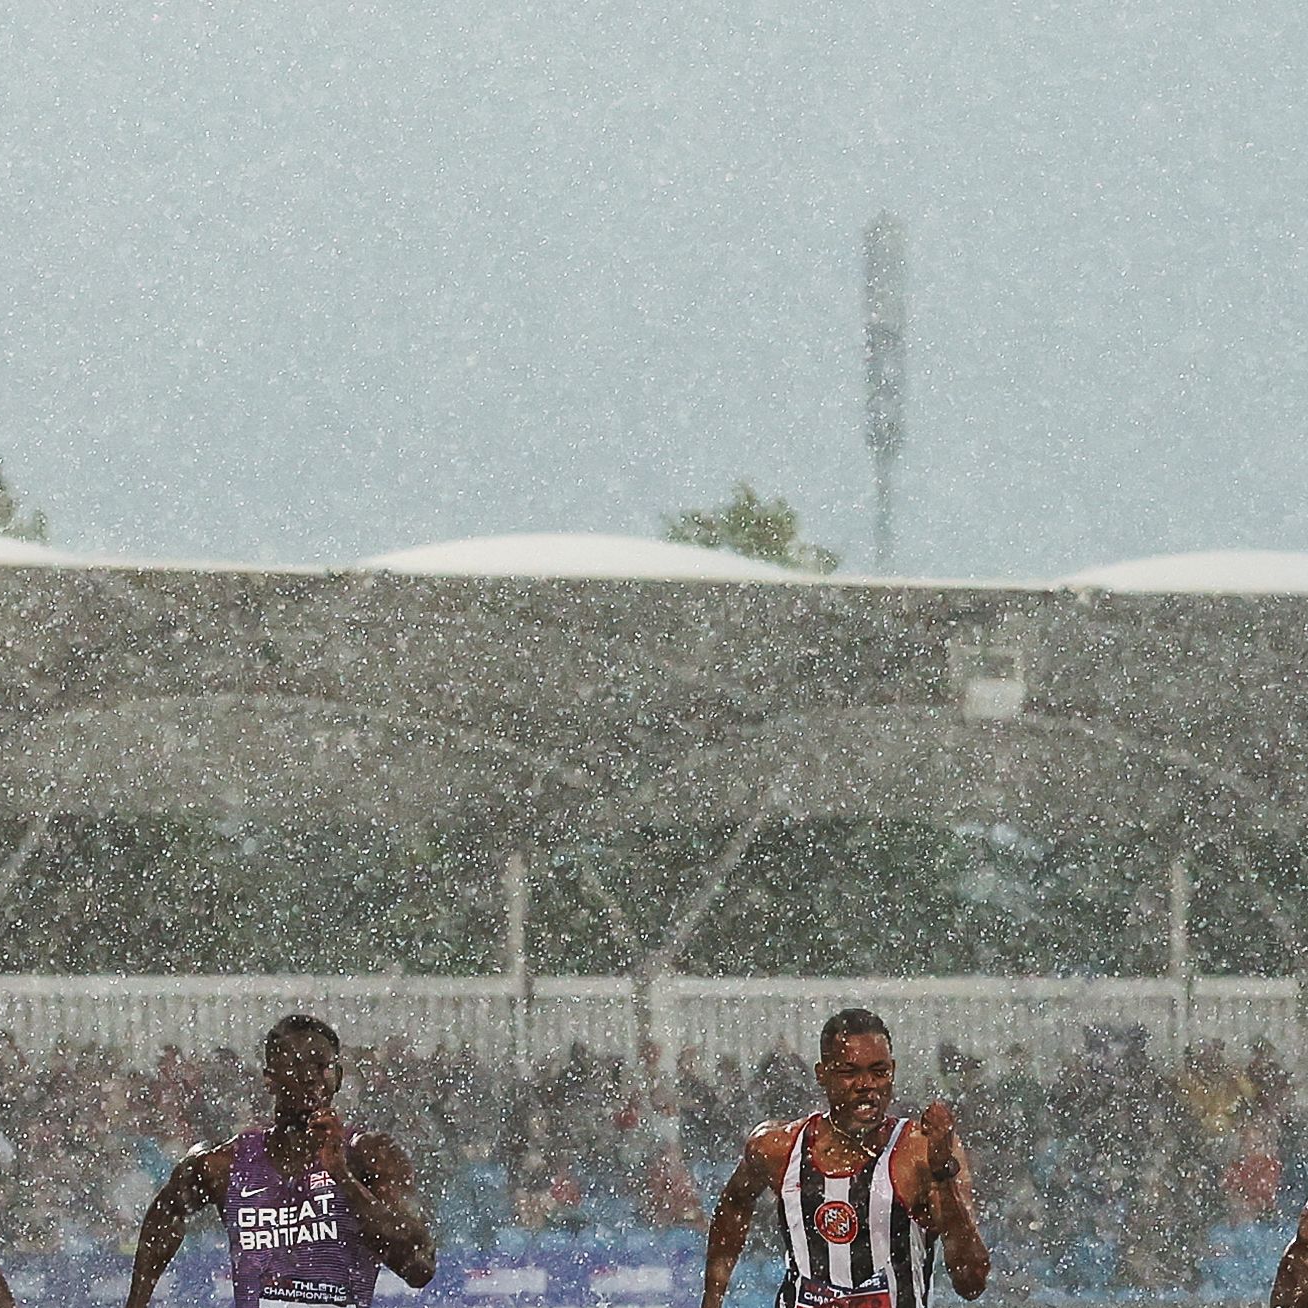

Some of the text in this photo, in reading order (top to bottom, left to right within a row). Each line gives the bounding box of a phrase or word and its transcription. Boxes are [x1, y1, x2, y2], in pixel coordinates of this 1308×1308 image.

[237, 1193, 335, 1228] GREAT
[239, 1220, 338, 1251] BRITAIN
[263, 1286, 348, 1302] CHAMPIONSHIP
